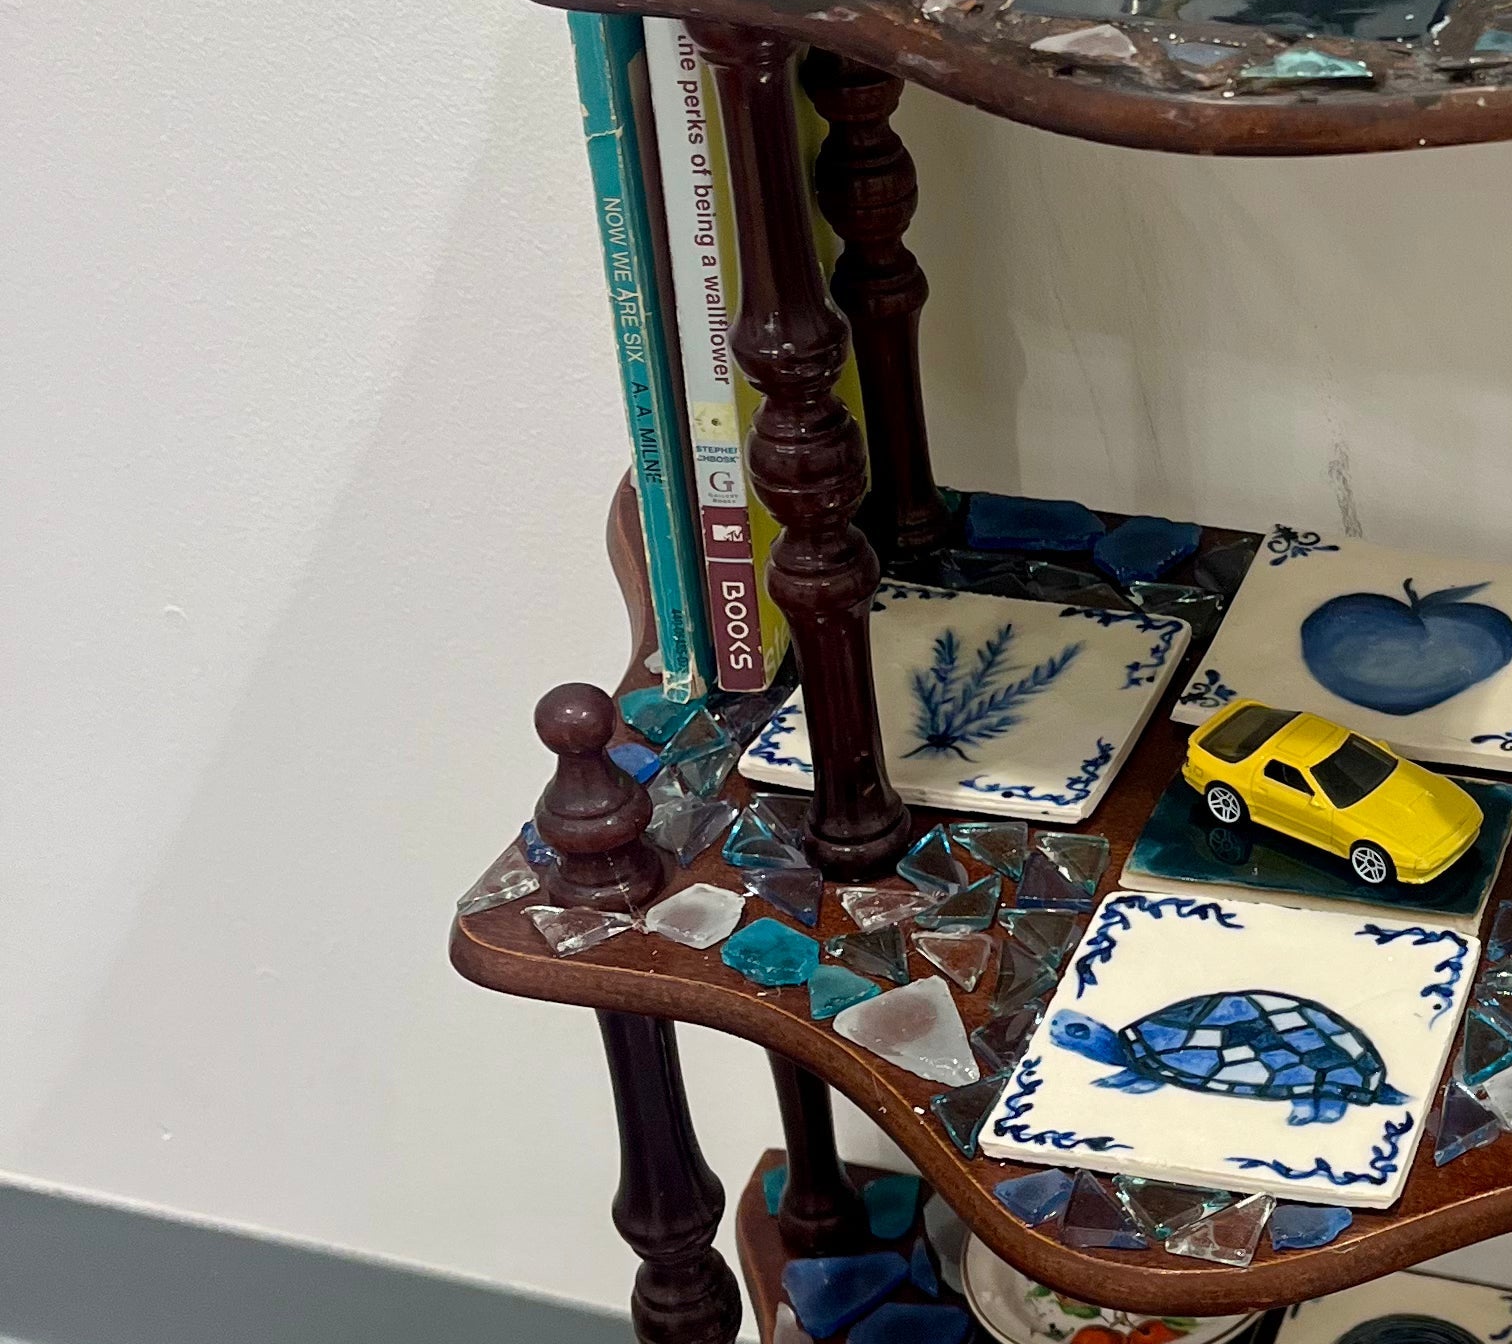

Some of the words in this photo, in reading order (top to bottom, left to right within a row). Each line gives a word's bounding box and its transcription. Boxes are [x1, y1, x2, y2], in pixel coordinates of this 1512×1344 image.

[677, 80, 707, 145] perks
[690, 154, 712, 176] of
[602, 197, 627, 246] NOW
[694, 185, 717, 247] being
[611, 252, 633, 282] WE
[702, 255, 717, 267] a
[616, 287, 640, 328] ARE
[623, 333, 645, 363] SIX
[704, 276, 730, 385] wallflower
[639, 428, 663, 484] MILNE
[709, 471, 735, 493] G
[721, 581, 753, 670] BOOKS
